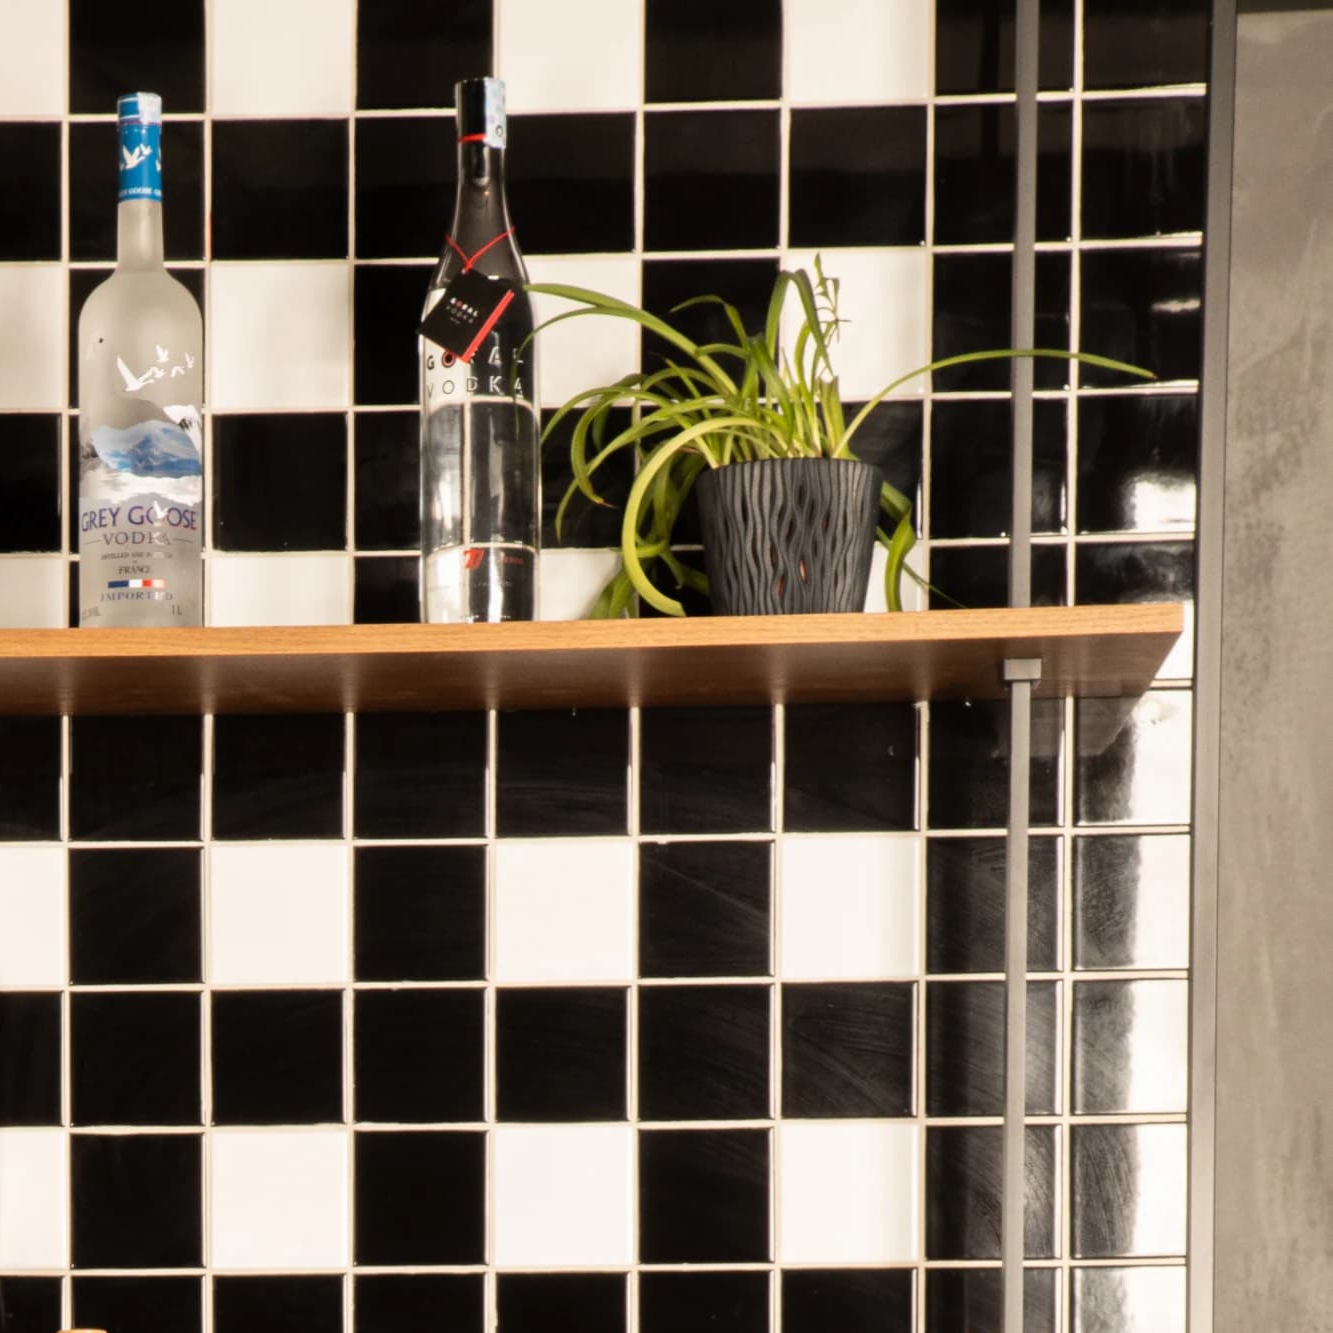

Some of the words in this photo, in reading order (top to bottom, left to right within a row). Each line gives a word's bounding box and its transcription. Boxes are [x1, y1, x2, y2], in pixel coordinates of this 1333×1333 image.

[426, 346, 524, 371] GOAL
[427, 376, 524, 400] VODKA
[82, 507, 120, 532] GREY
[128, 505, 197, 531] GOOSE
[103, 531, 171, 546] VODKA
